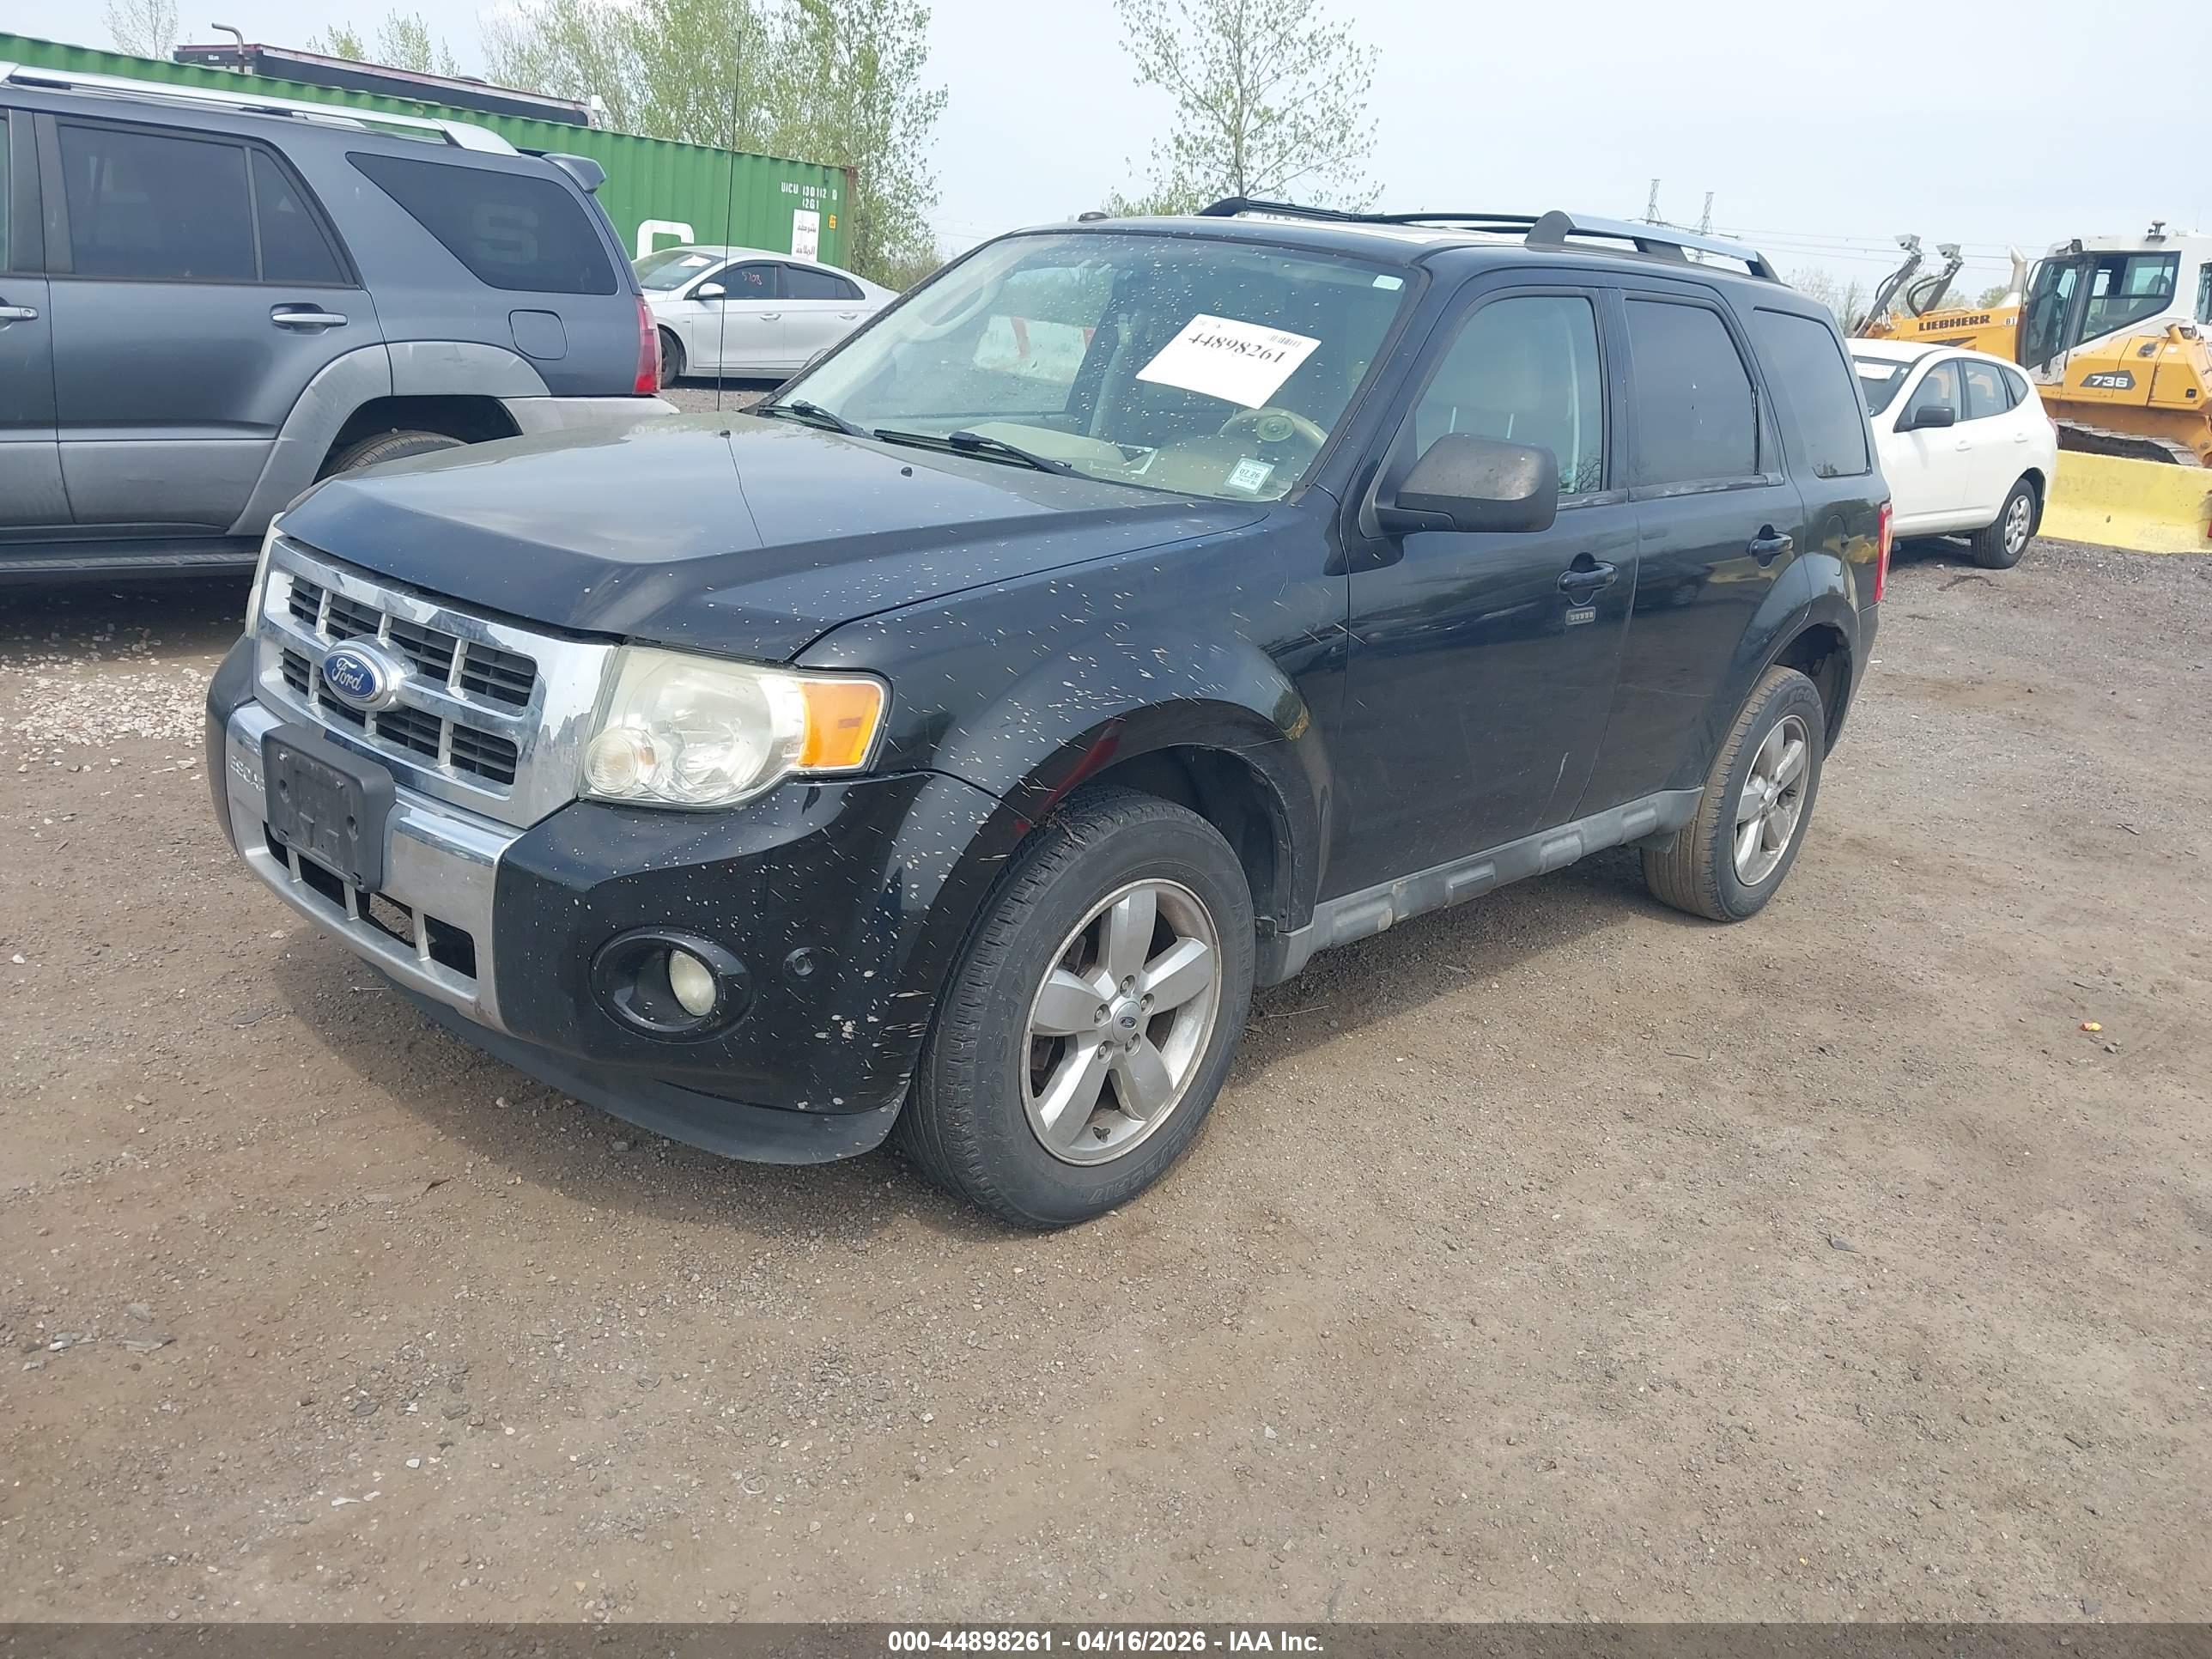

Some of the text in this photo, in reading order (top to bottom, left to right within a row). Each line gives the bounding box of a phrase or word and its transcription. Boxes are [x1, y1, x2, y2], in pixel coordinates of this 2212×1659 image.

[1918, 314, 1990, 331] LIEBHERR
[1188, 333, 1286, 362] 44898261
[2091, 375, 2129, 387] 736
[331, 657, 365, 691] Ford
[230, 755, 265, 792] ESCAP
